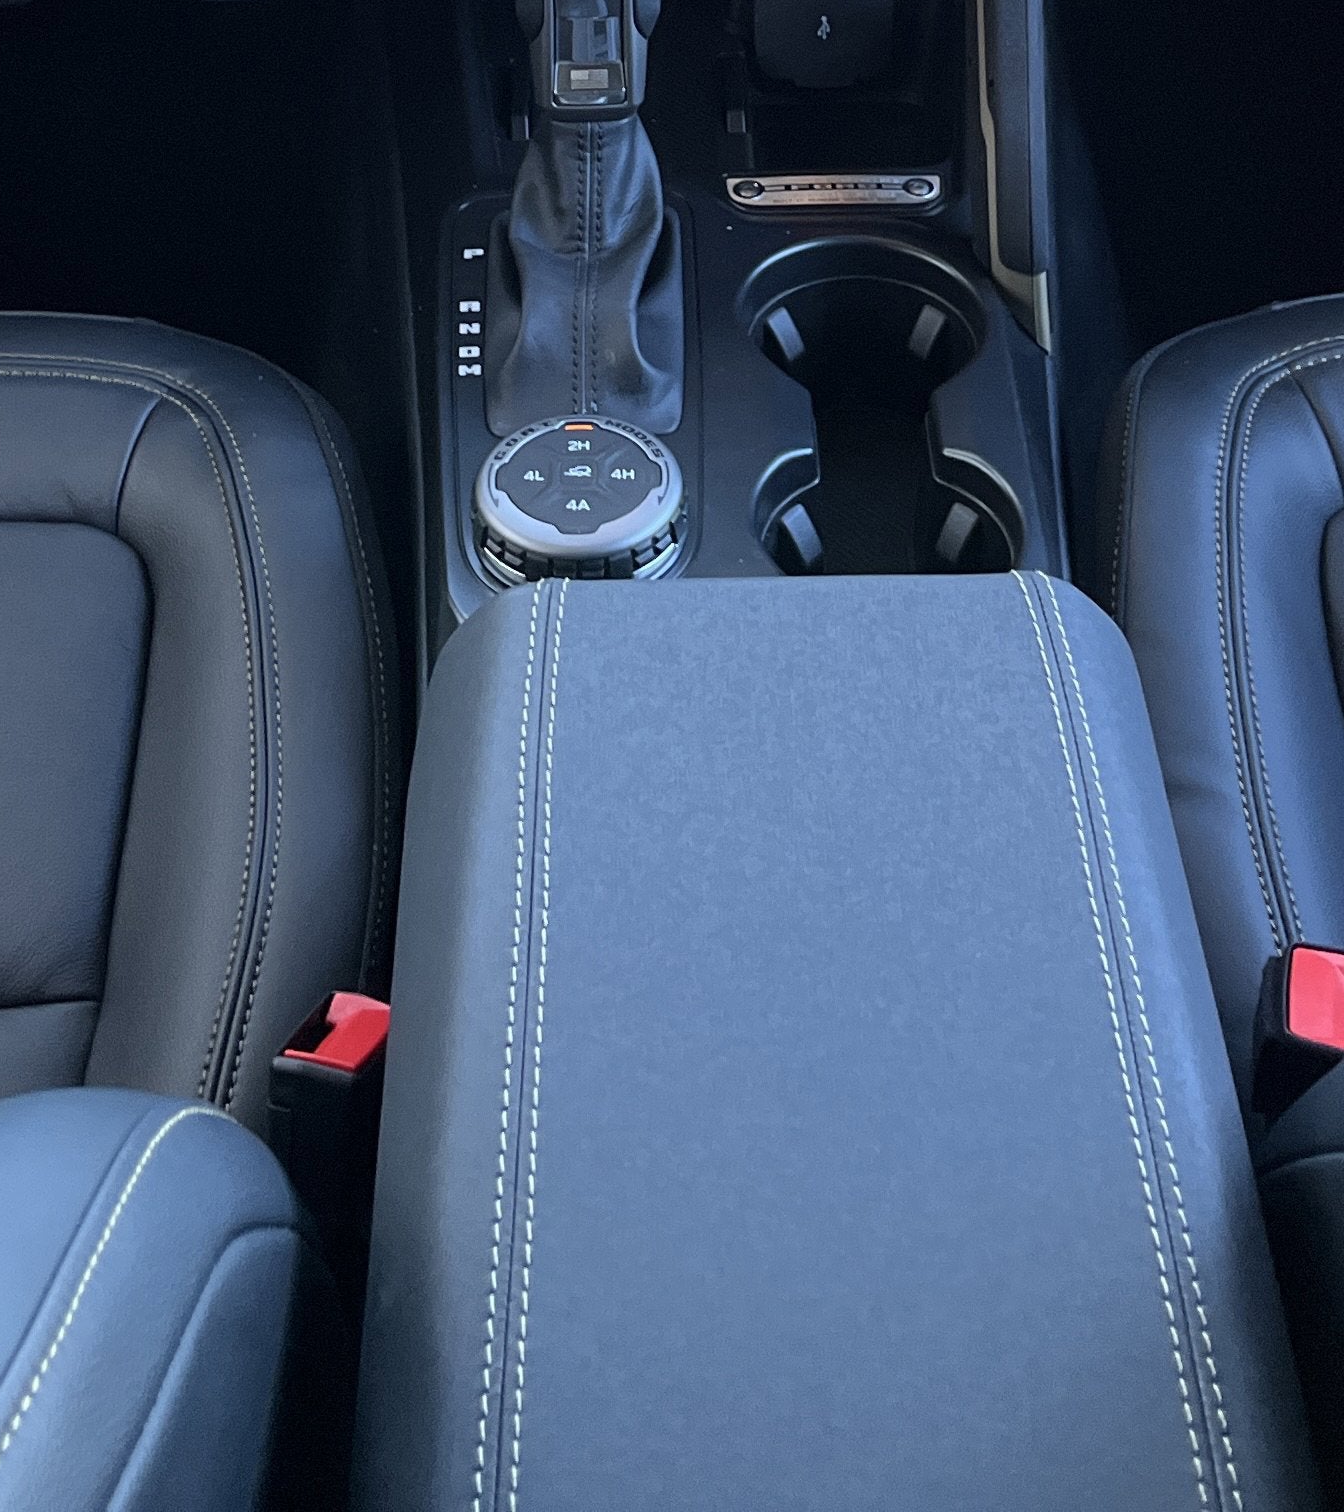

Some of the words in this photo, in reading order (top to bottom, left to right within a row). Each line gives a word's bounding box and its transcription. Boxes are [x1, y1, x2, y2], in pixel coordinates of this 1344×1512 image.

[463, 248, 484, 260] P
[459, 322, 481, 335] N
[458, 364, 482, 377] M
[605, 419, 665, 459] MODES
[567, 440, 591, 452] 2H
[523, 470, 545, 482] 4L
[610, 468, 636, 480] 4H
[565, 499, 591, 512] 4A
